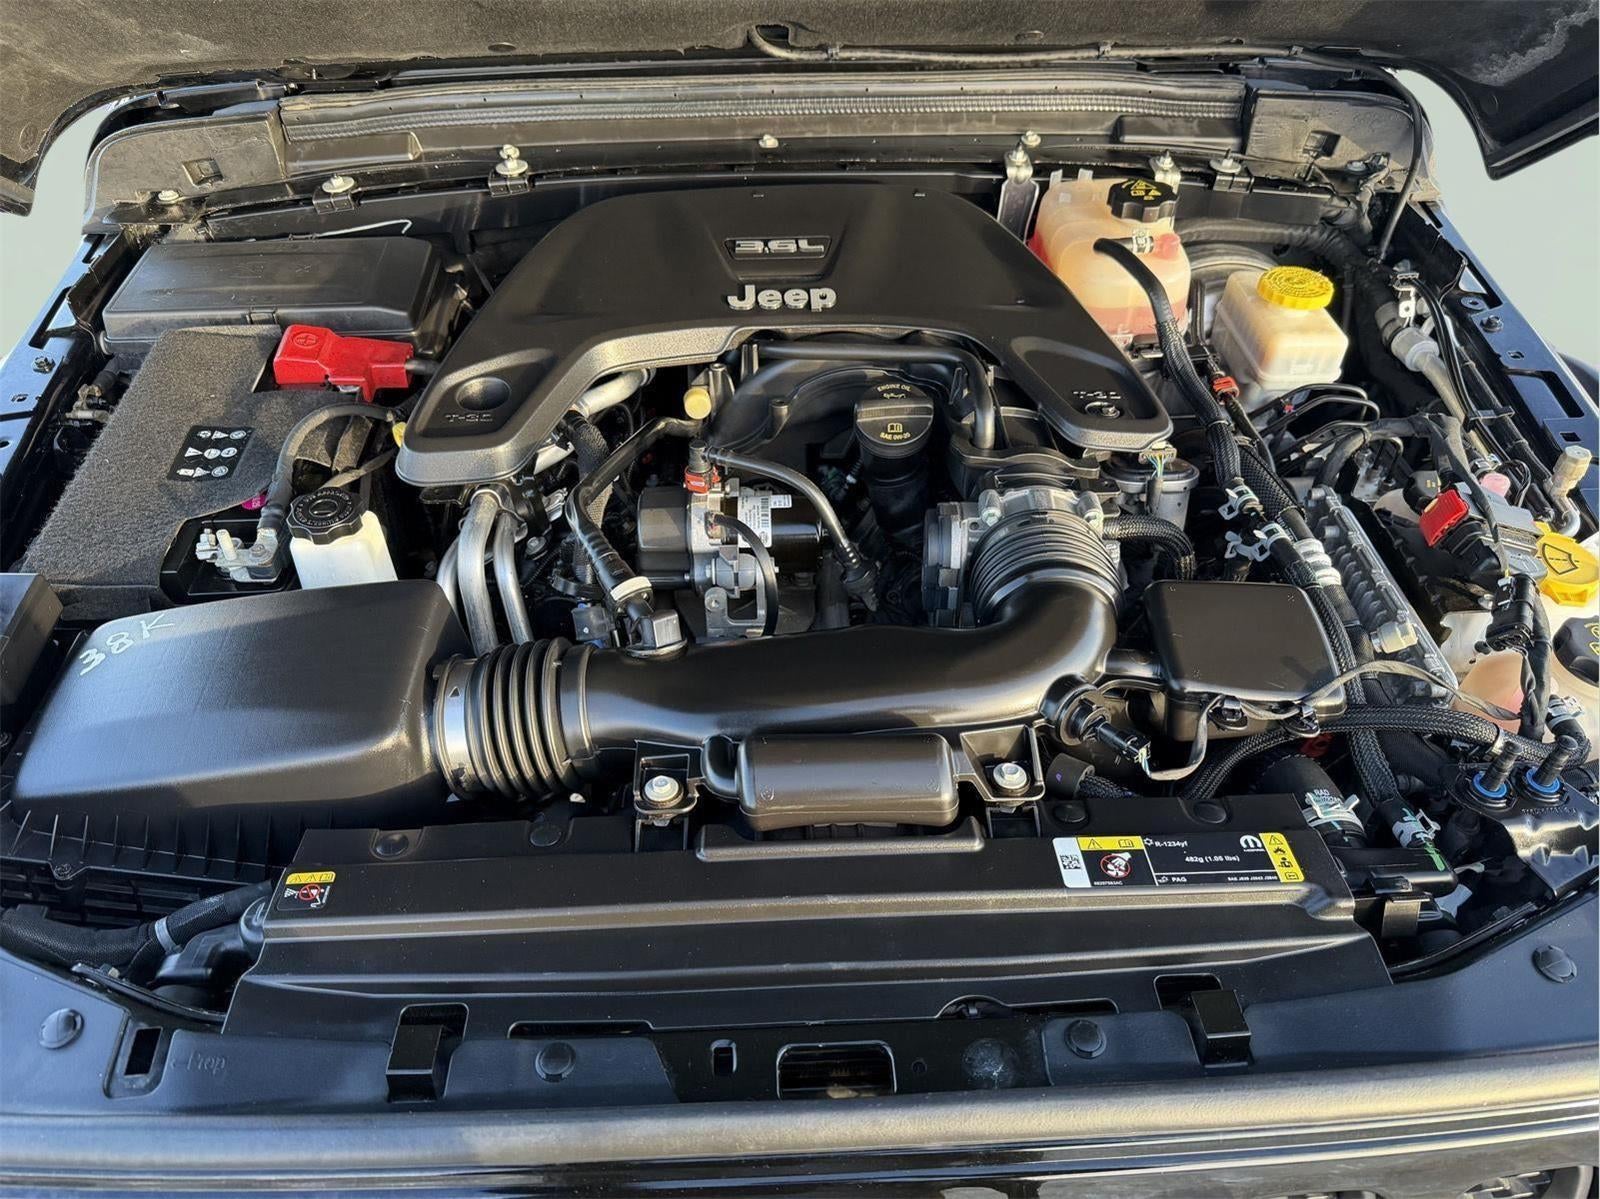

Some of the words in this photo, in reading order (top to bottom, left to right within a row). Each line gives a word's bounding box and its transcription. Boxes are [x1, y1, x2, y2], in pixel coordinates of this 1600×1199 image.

[735, 239, 824, 254] 3.6L
[727, 284, 836, 312] Jeep
[877, 384, 900, 392] ENGINE
[901, 384, 911, 392] OIL
[880, 432, 892, 440] SAE
